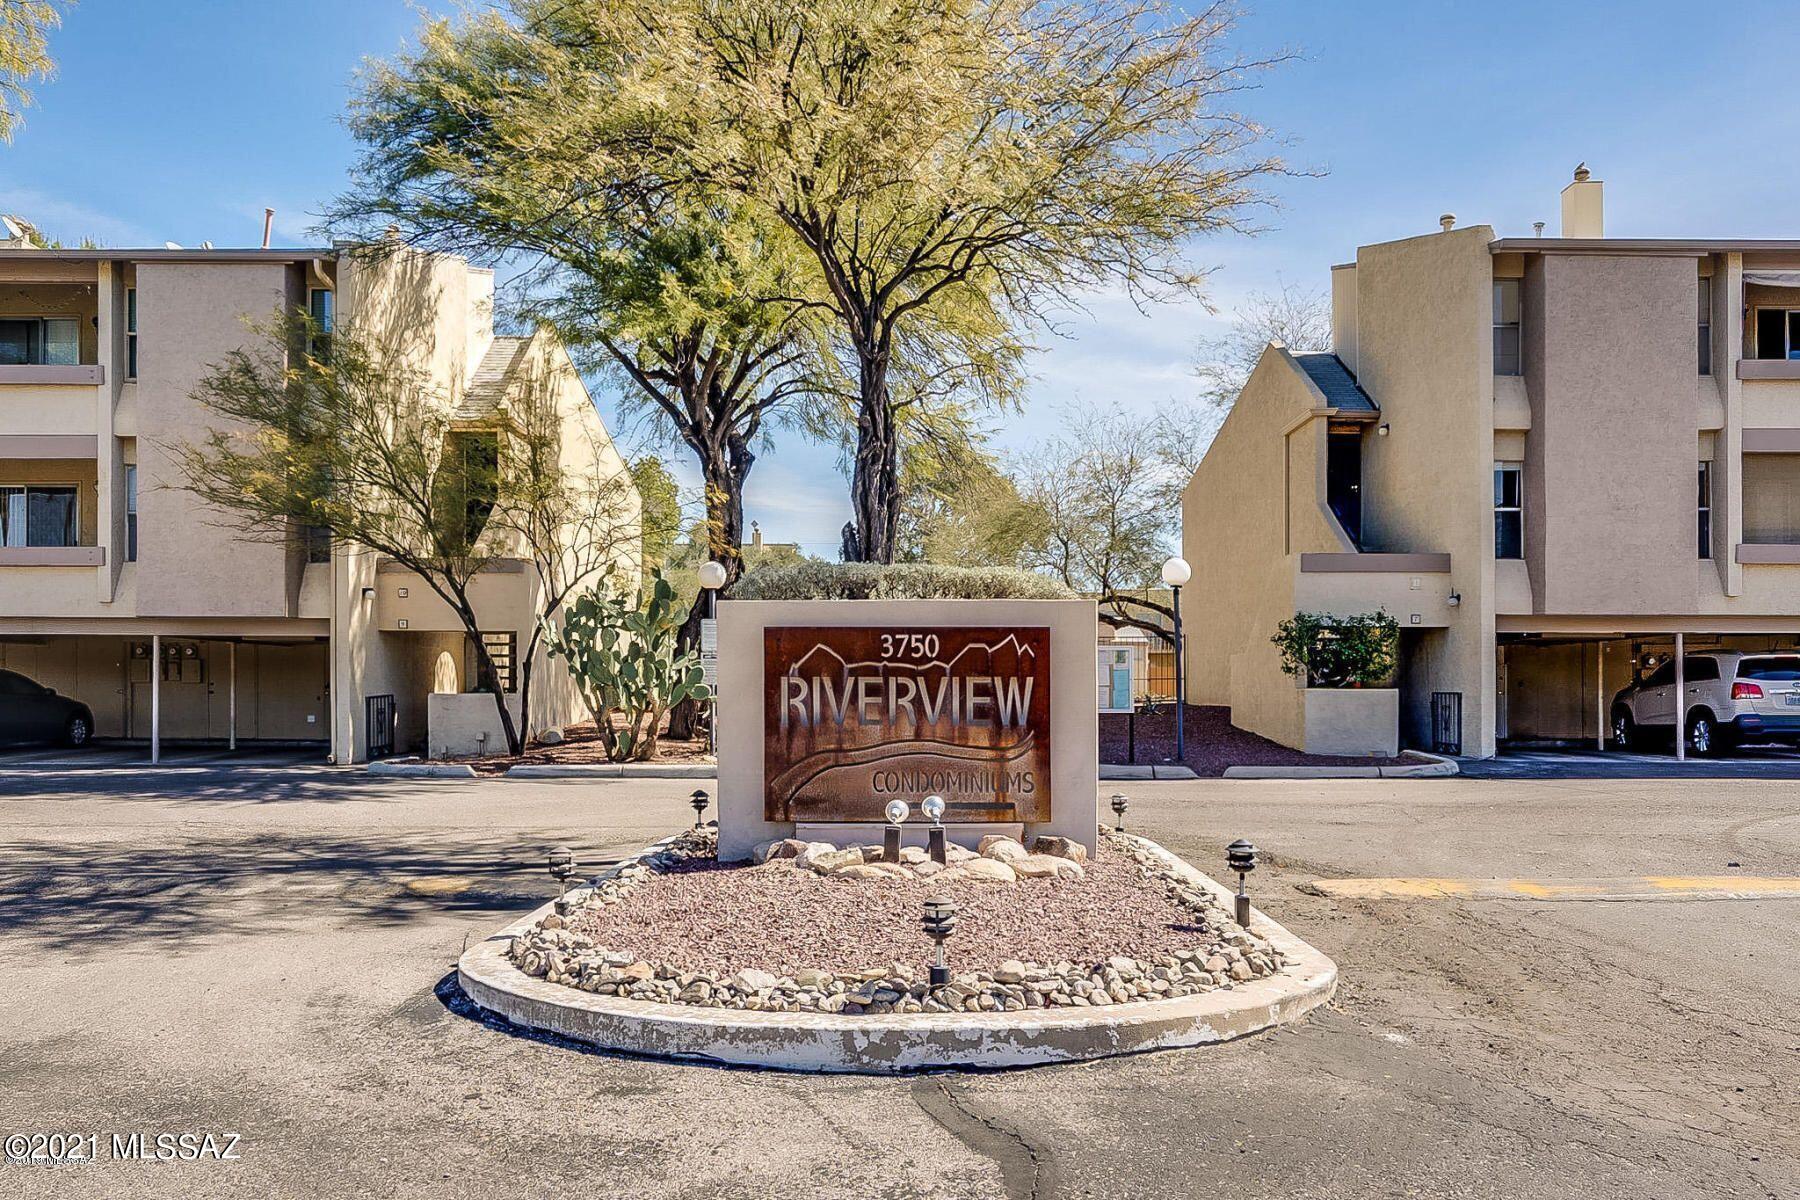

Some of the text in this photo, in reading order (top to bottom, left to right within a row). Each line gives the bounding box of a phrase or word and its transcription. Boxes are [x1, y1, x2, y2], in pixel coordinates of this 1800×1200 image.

[880, 634, 940, 658] 3750
[780, 676, 1035, 727] RIVERVIEW
[872, 771, 1035, 793] CONDOMINIUMS
